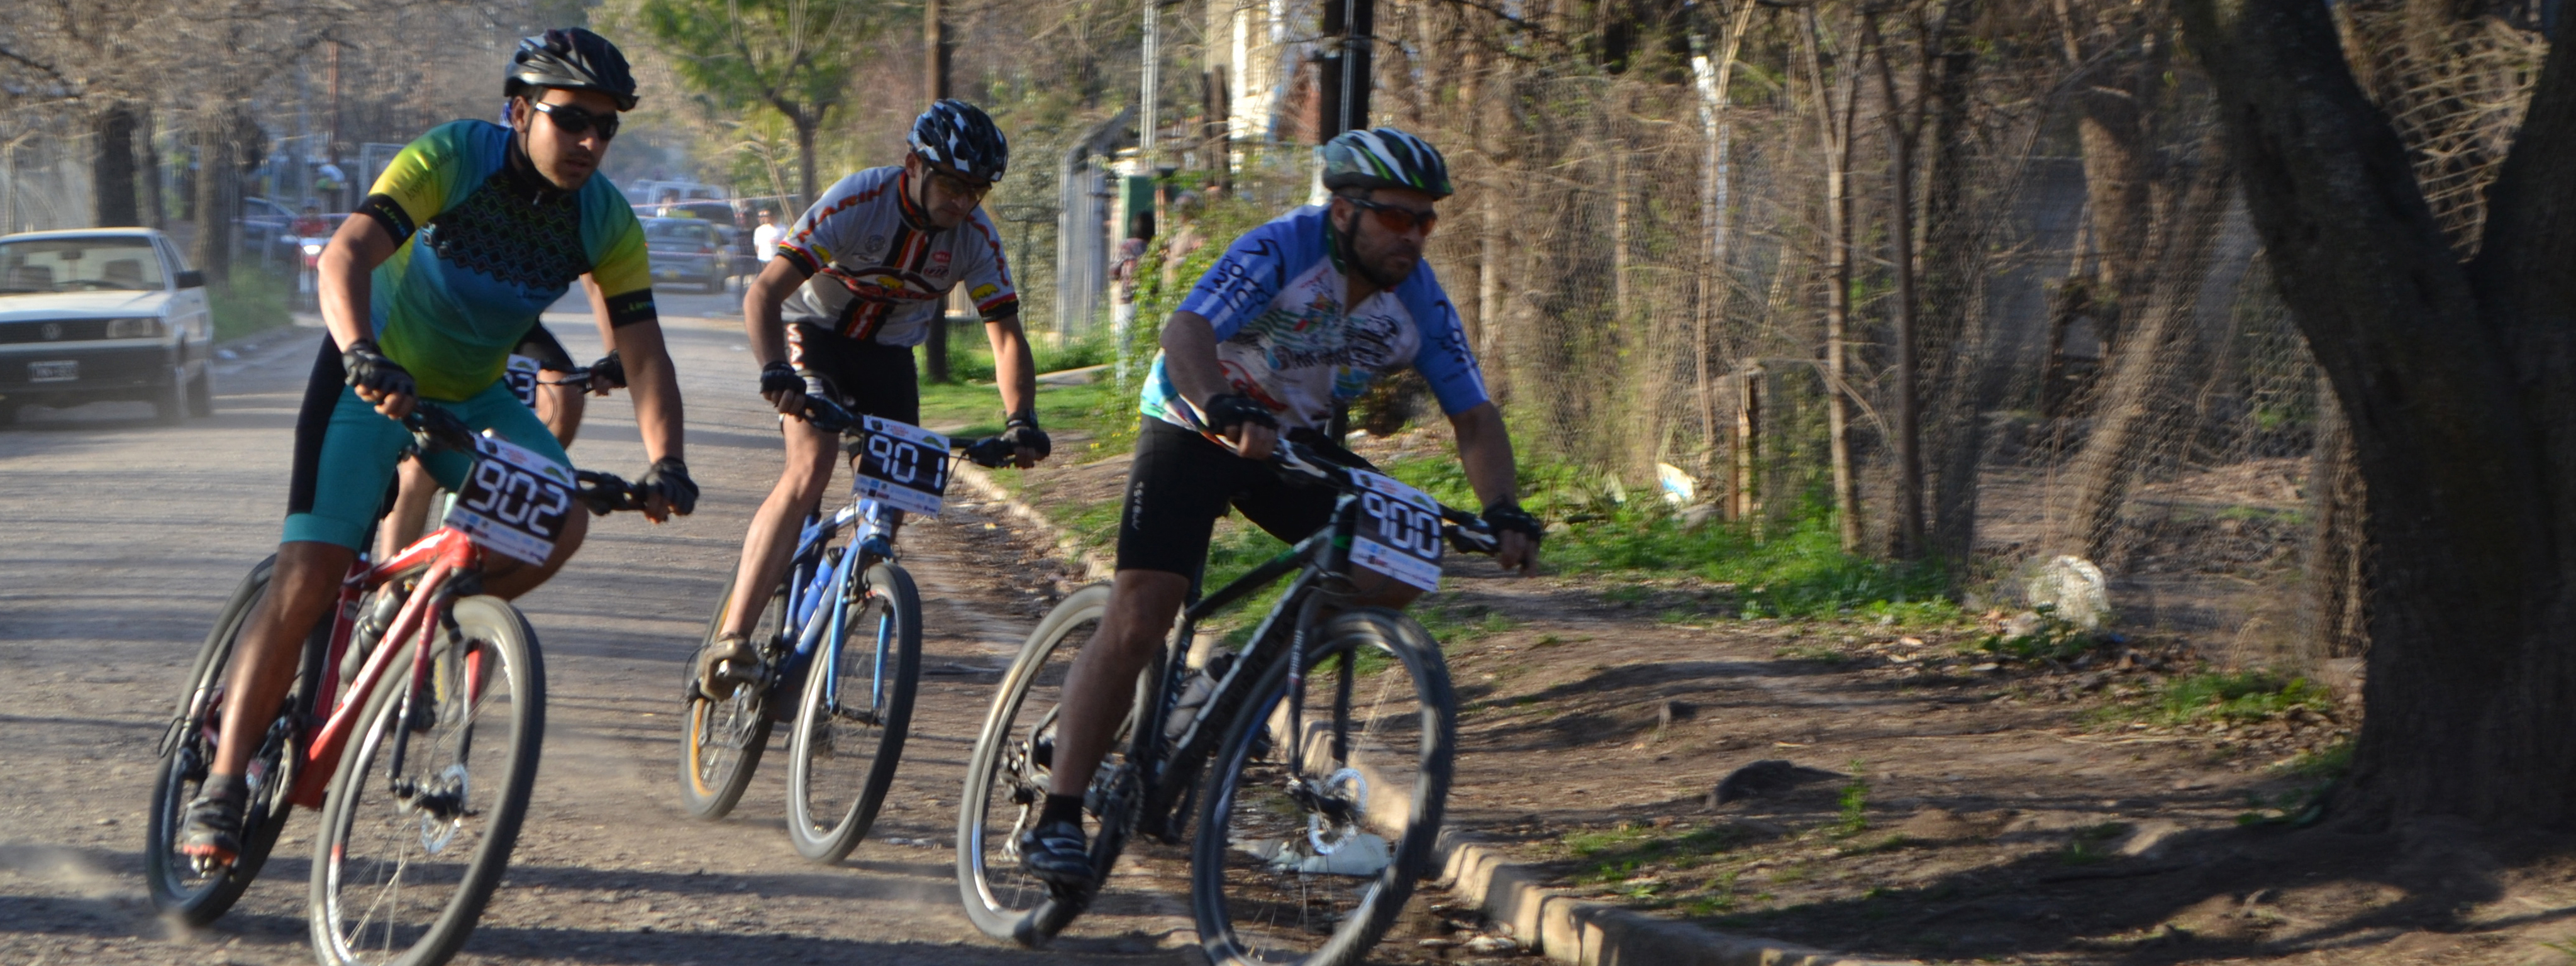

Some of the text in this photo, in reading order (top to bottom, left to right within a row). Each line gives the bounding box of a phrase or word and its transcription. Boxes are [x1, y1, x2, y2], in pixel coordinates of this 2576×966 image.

[868, 434, 945, 489] 901
[466, 458, 568, 536] 902
[1361, 491, 1441, 560] 900
